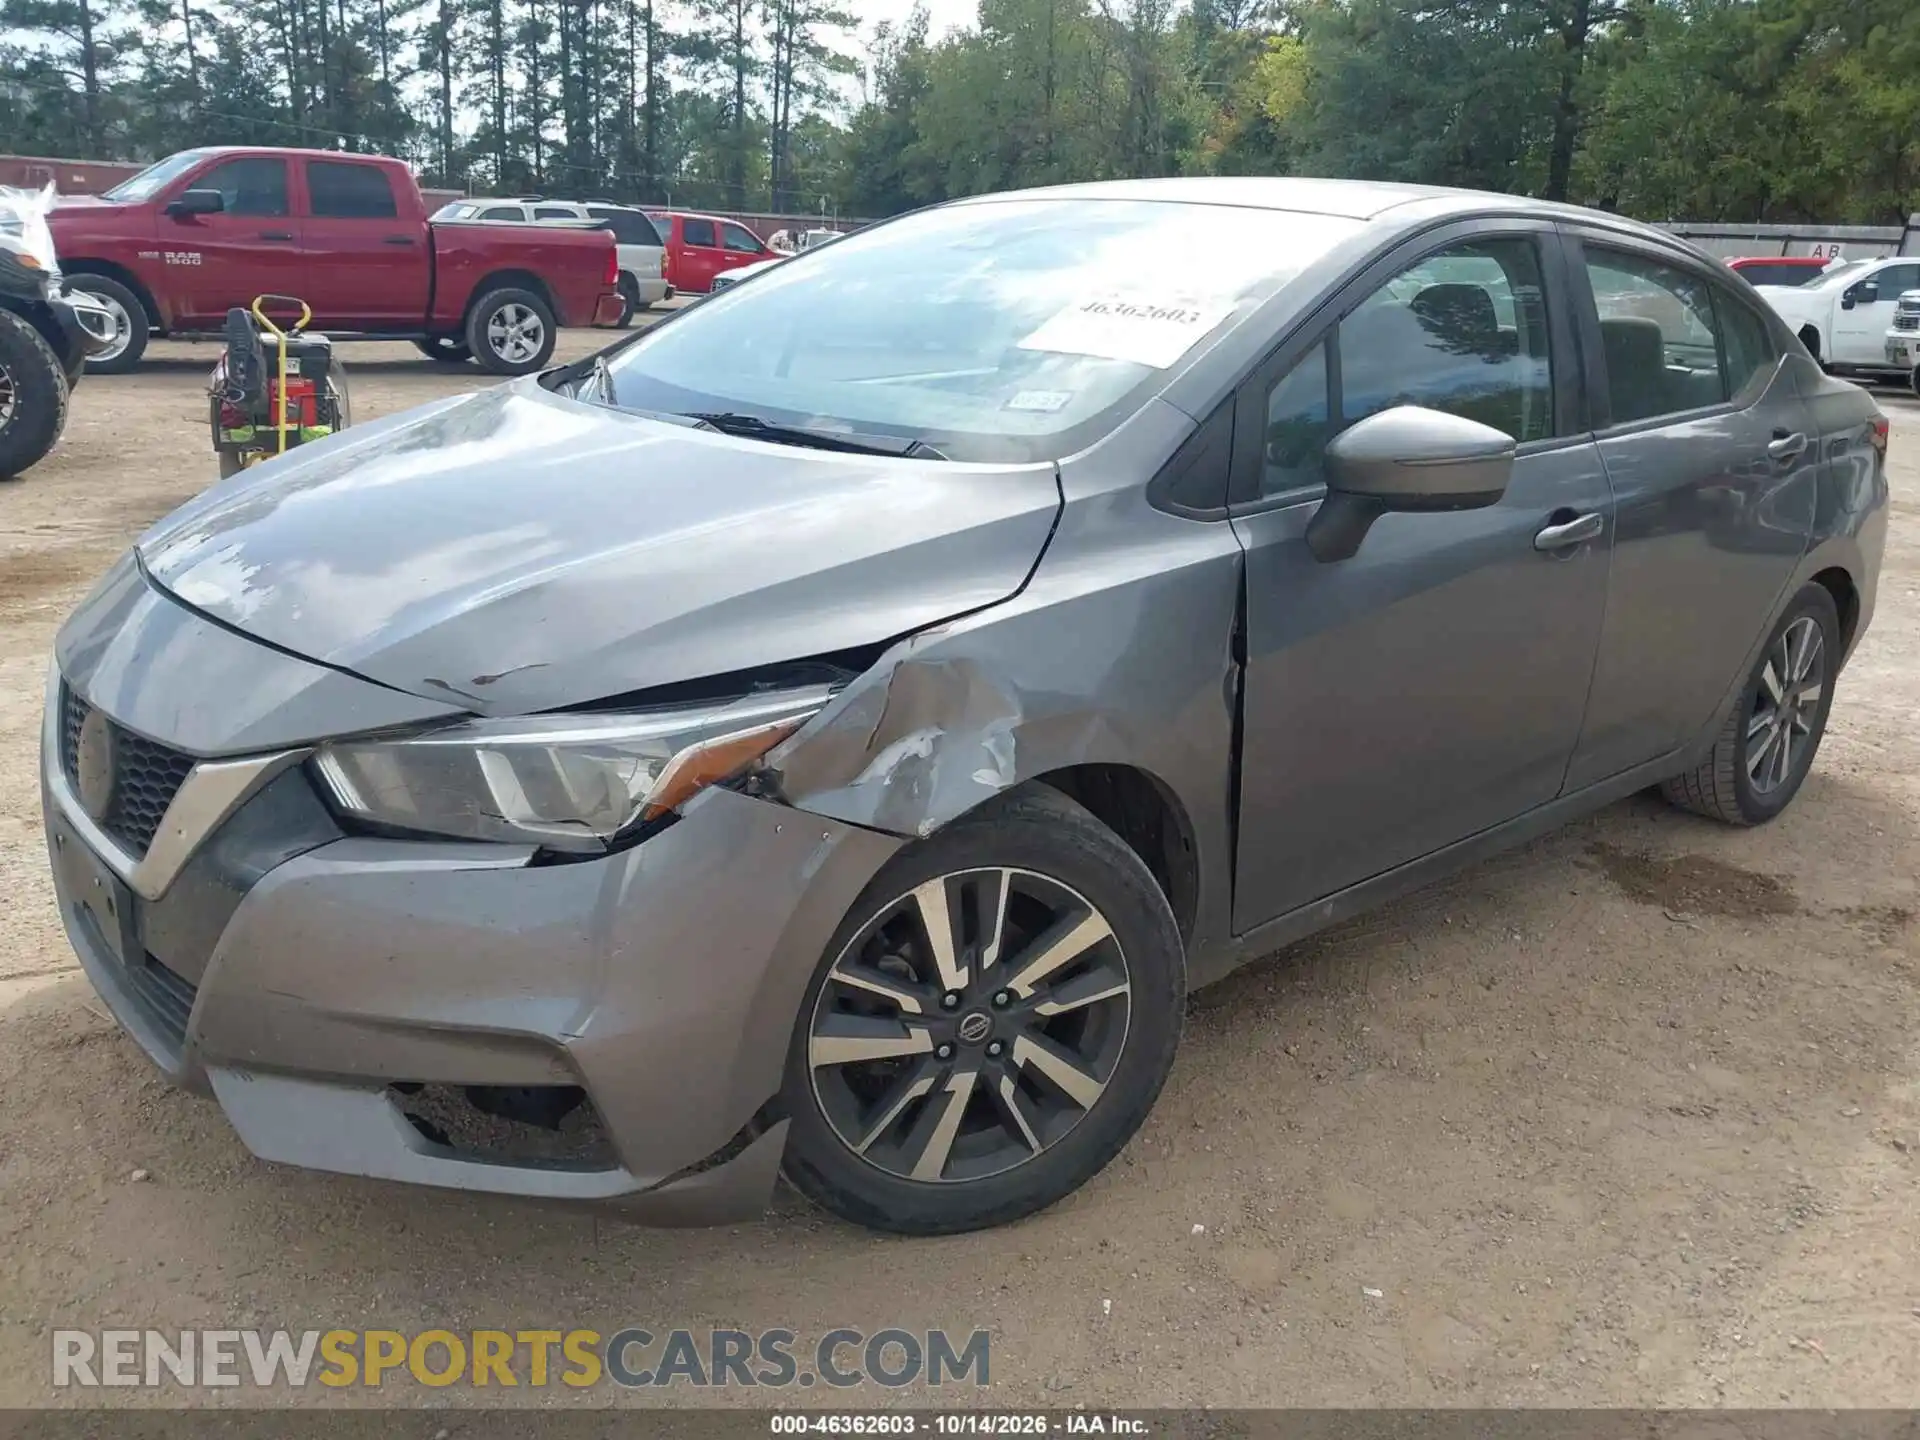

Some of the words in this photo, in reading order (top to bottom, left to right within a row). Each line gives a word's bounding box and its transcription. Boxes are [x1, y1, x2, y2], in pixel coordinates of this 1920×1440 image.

[164, 251, 201, 259] RAM
[1812, 244, 1823, 258] A
[1829, 244, 1841, 258] B
